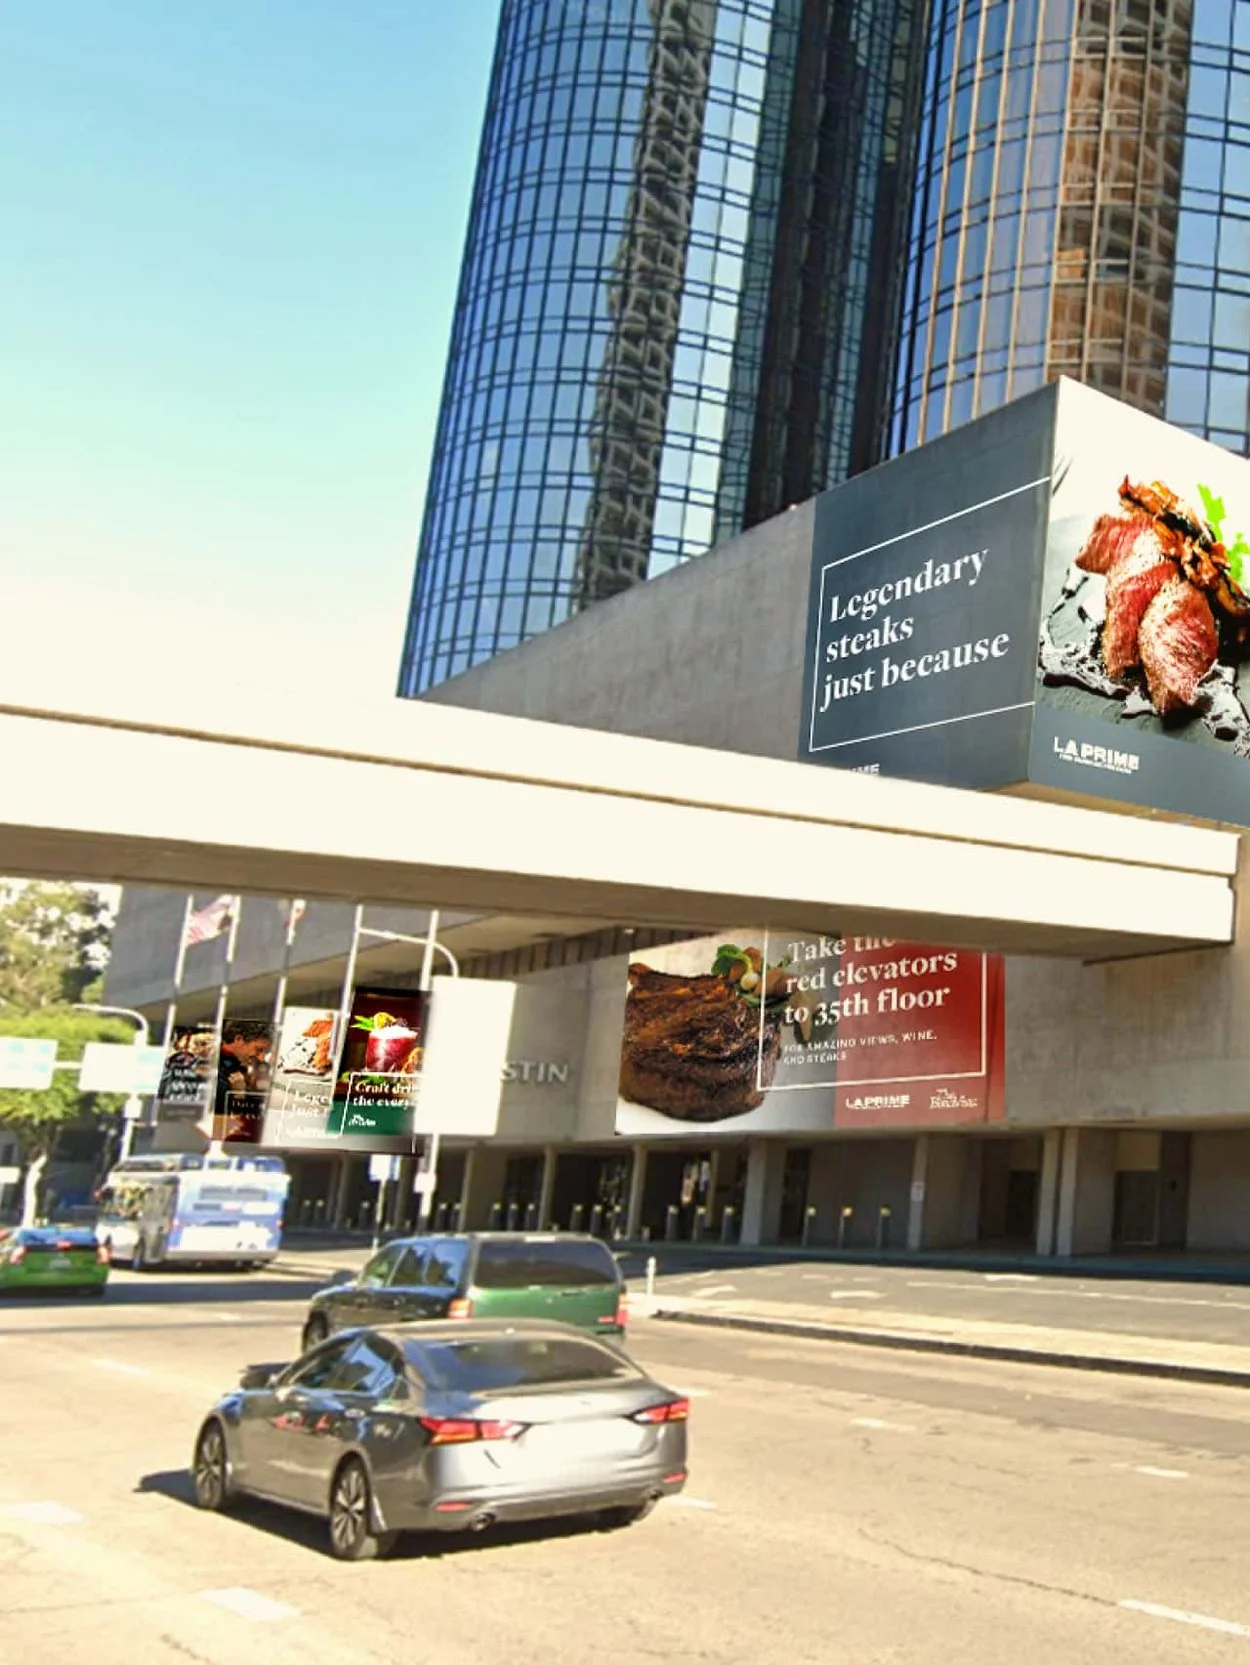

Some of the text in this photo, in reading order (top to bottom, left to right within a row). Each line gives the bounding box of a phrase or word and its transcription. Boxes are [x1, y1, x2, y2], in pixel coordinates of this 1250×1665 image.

[830, 549, 989, 622] Legendary
[826, 616, 914, 662] steaks
[820, 633, 1009, 712] just because
[786, 936, 847, 963] Take
[786, 952, 958, 993] red elevators
[784, 986, 951, 1027] to 35th floor
